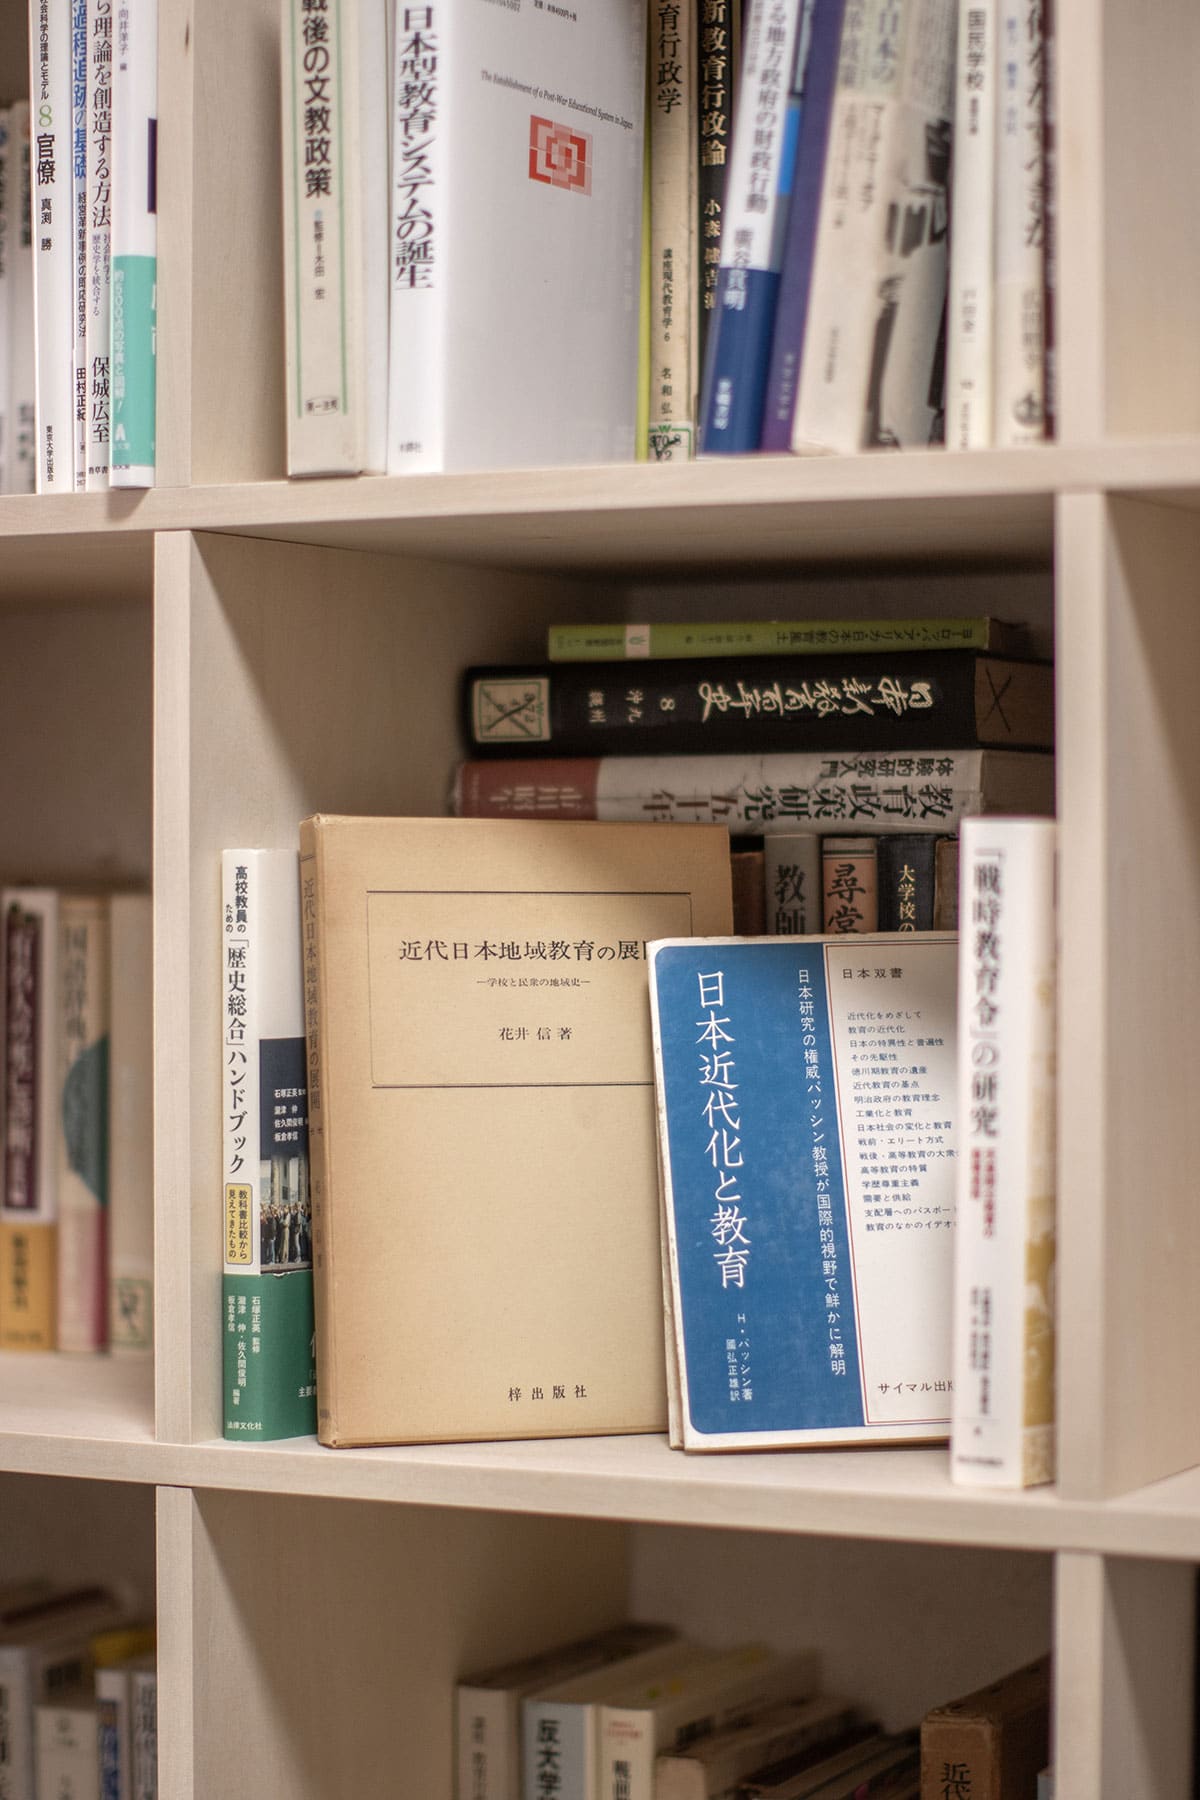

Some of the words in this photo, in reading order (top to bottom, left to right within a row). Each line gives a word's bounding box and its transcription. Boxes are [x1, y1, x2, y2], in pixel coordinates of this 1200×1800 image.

[967, 10, 987, 91] 国民学校
[72, 0, 87, 179] 過程追跡の基礎
[481, 70, 492, 82] The
[493, 75, 532, 95] Establishment
[544, 90, 568, 107] Post-War
[568, 98, 598, 117] Educational
[598, 107, 614, 122] System
[620, 116, 633, 130] Japan
[396, 6, 438, 291] 日本型教育システムの誕生
[37, 133, 55, 186] 官僚
[92, 356, 110, 444] 保城広至
[660, 697, 676, 712] 8
[819, 756, 954, 779] 体験的研究入門
[643, 783, 954, 822] 教育政策研究五十年
[235, 866, 248, 933] 高校教員の
[775, 864, 806, 934] 教師
[224, 904, 234, 933] ための
[399, 940, 649, 961] 近代日本地域教育の展
[842, 968, 903, 979] 日本双書
[847, 1011, 921, 1021] 近代化をめざして
[848, 1025, 905, 1034] 教育の近代化
[850, 1038, 944, 1048] 日本の特異性と普遍性
[226, 938, 249, 1174] 「歴史総合」ハンドブック
[852, 1066, 928, 1076] 徳川期教育の遺産
[853, 1080, 920, 1090] 近代教育の基点
[854, 1093, 941, 1104] 明治政府の教育理念
[856, 1108, 913, 1118] 工業化と教育
[696, 970, 752, 1289] 日本近代化と教育
[857, 1121, 952, 1132] 日本社会の変化と教育
[858, 1135, 945, 1147] 戦前・エリート方式
[861, 1164, 927, 1174] 高等教育の特質
[862, 1178, 920, 1188] 学歴尊重主義
[863, 1193, 912, 1203] 需要と供給
[228, 1188, 238, 1259] 見えてきたもの
[238, 1189, 248, 1260] 教科書比較から
[866, 1219, 957, 1232] 教育のなかのイデオ
[508, 1385, 587, 1402] 梓出版社
[227, 1420, 262, 1431] 法律文化社
[536, 1719, 563, 1800] 反大学
